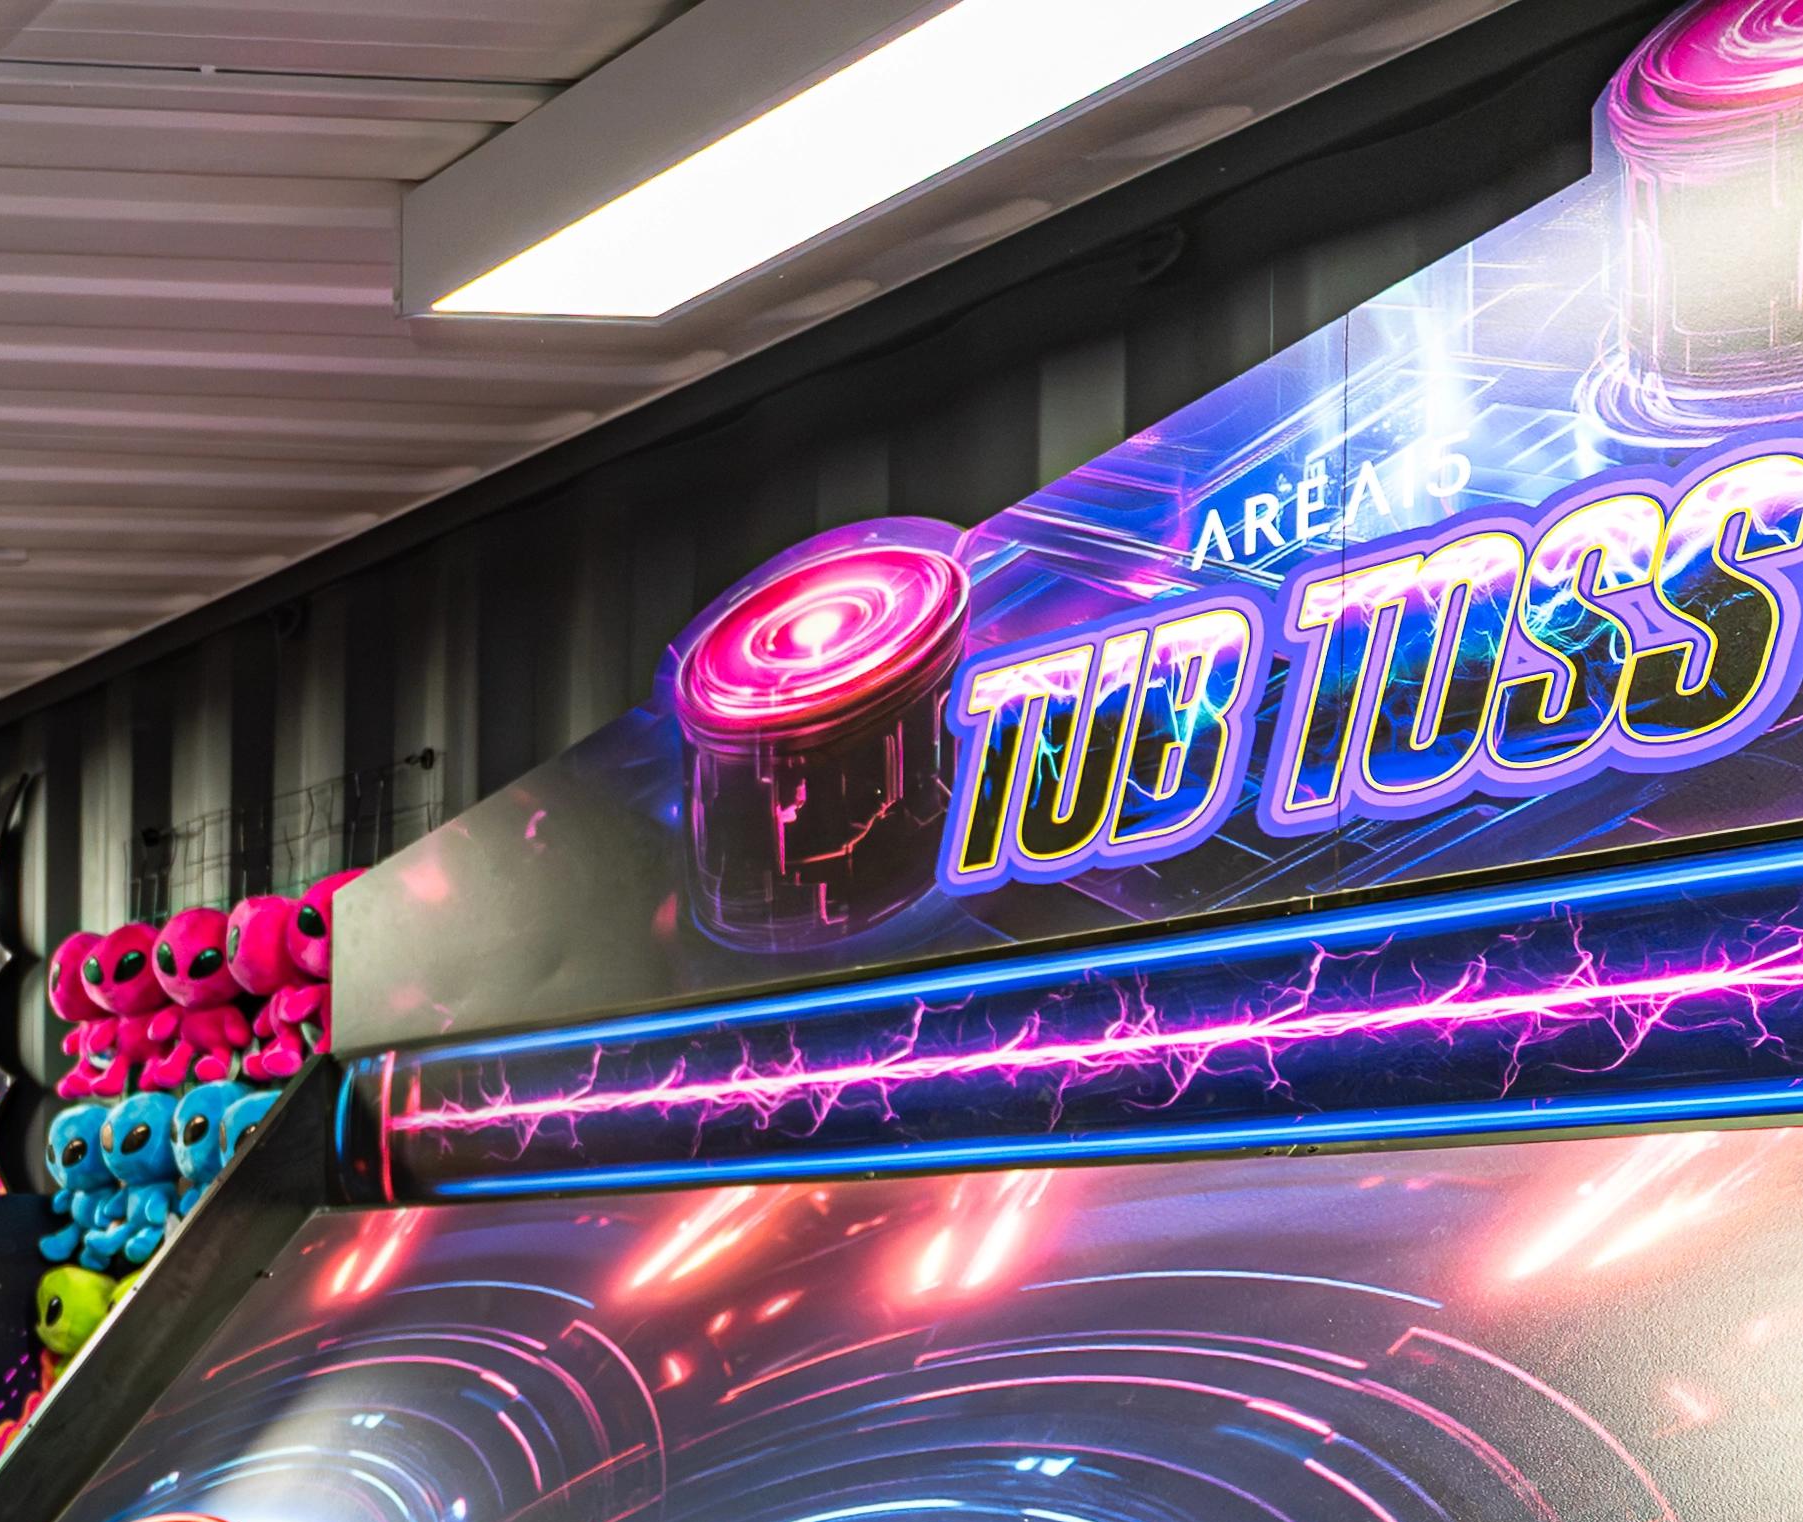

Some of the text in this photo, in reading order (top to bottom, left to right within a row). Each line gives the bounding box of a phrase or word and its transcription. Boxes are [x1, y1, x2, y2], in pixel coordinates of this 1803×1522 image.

[1190, 430, 1472, 572] AREA15
[956, 452, 1803, 875] TUB TOSS
